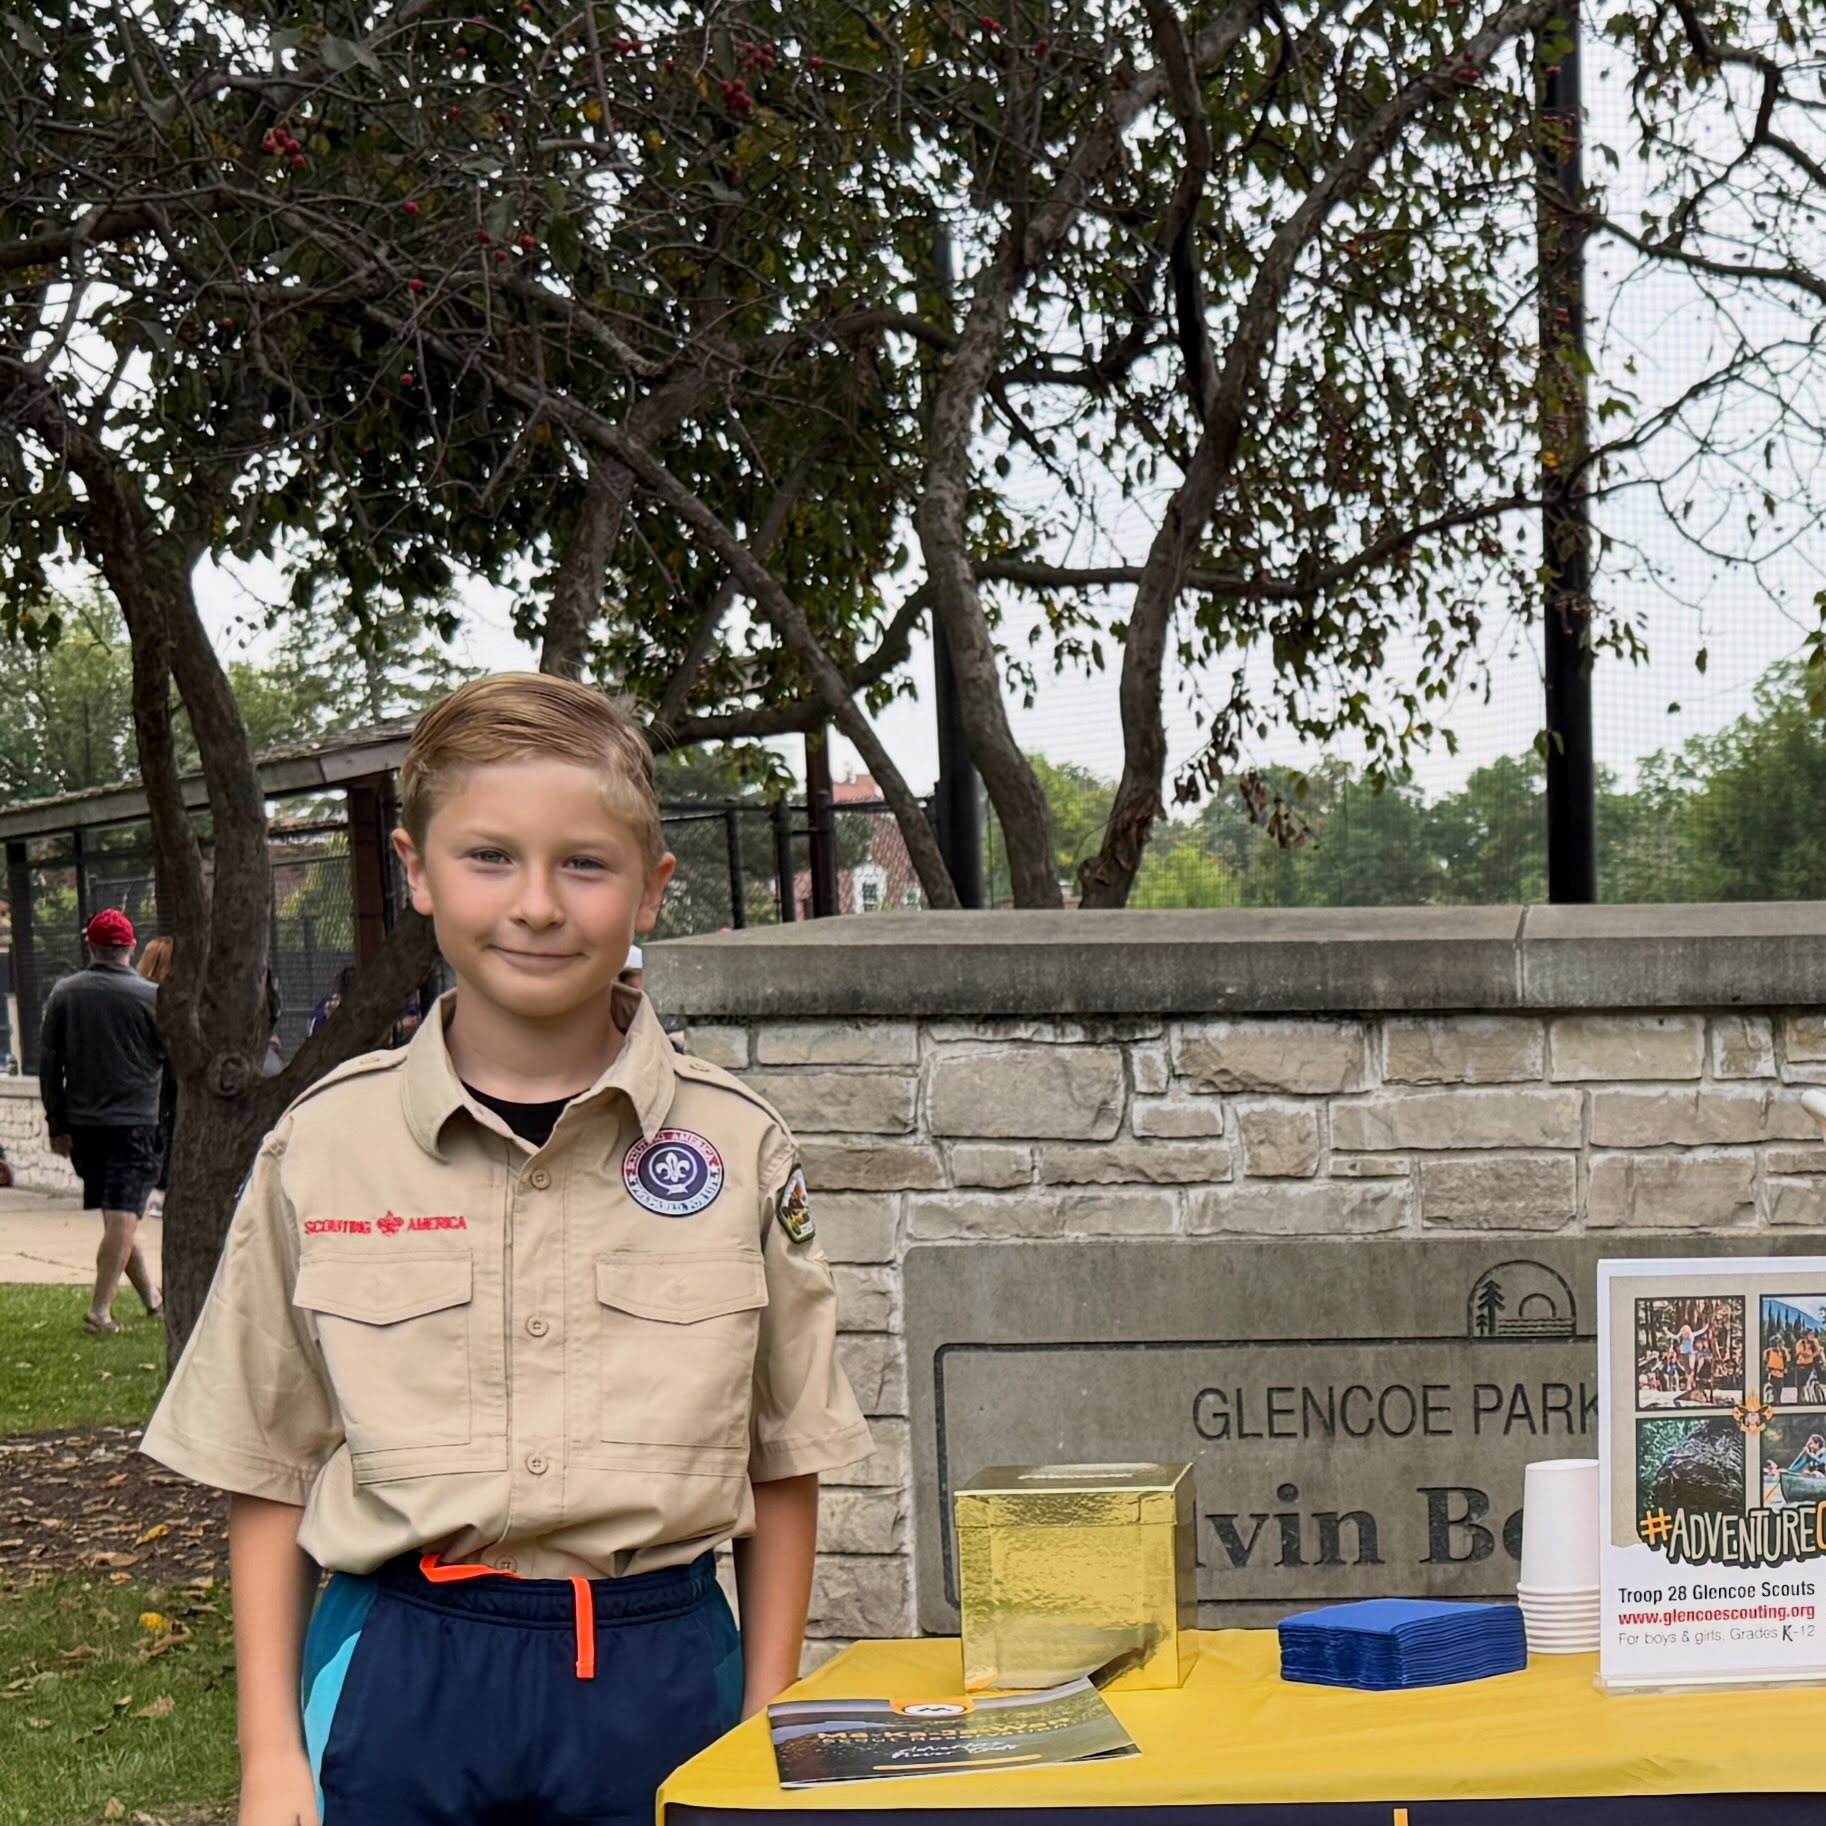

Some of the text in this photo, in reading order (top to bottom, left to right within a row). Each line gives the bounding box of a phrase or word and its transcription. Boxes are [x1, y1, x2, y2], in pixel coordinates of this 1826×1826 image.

[304, 1215, 467, 1235] SCOUTING AMERICA
[1192, 1383, 1453, 1440] GLENCOE
[1618, 1580, 1815, 1605] Troop 28 Glencoe Scouts
[1618, 1604, 1815, 1627] www.glencoescouting.org
[1619, 1632, 1640, 1646] For
[1645, 1632, 1677, 1647] boys
[1682, 1630, 1690, 1643] &
[1730, 1627, 1778, 1641] Grades
[1782, 1624, 1815, 1642] K-12
